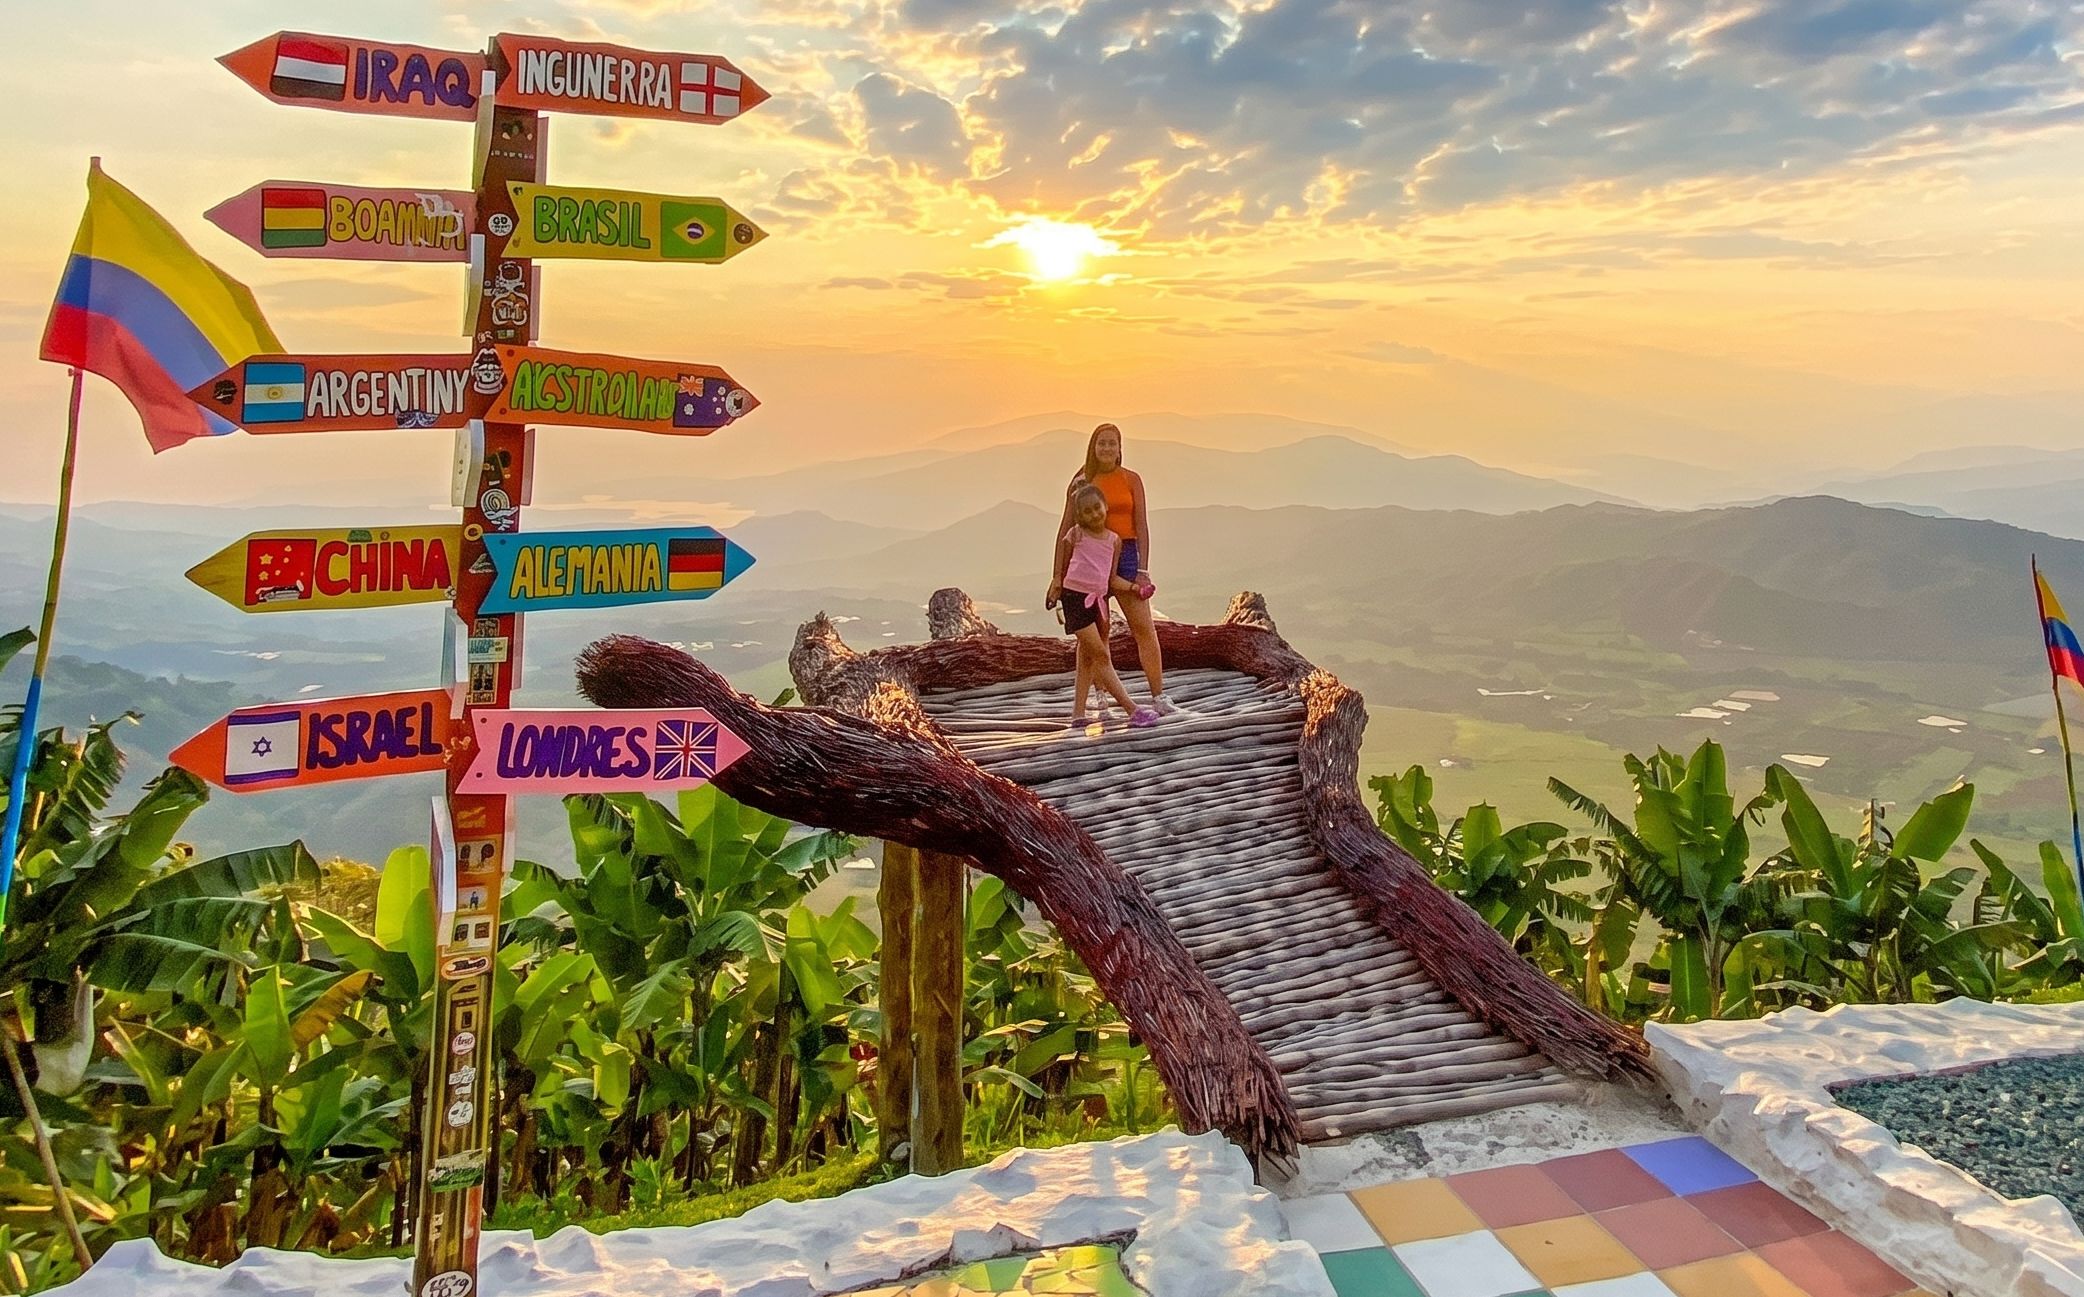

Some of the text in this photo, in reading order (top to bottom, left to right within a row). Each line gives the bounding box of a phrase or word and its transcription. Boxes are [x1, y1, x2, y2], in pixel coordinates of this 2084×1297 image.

[353, 47, 476, 108] IRAQ
[517, 48, 674, 110] INGUNERRA
[534, 195, 651, 250] BRASIL
[314, 538, 452, 596] CHINA
[509, 543, 664, 599] ALEMANIA
[305, 701, 444, 770] ISRAEL
[497, 722, 652, 780] LONDRES
